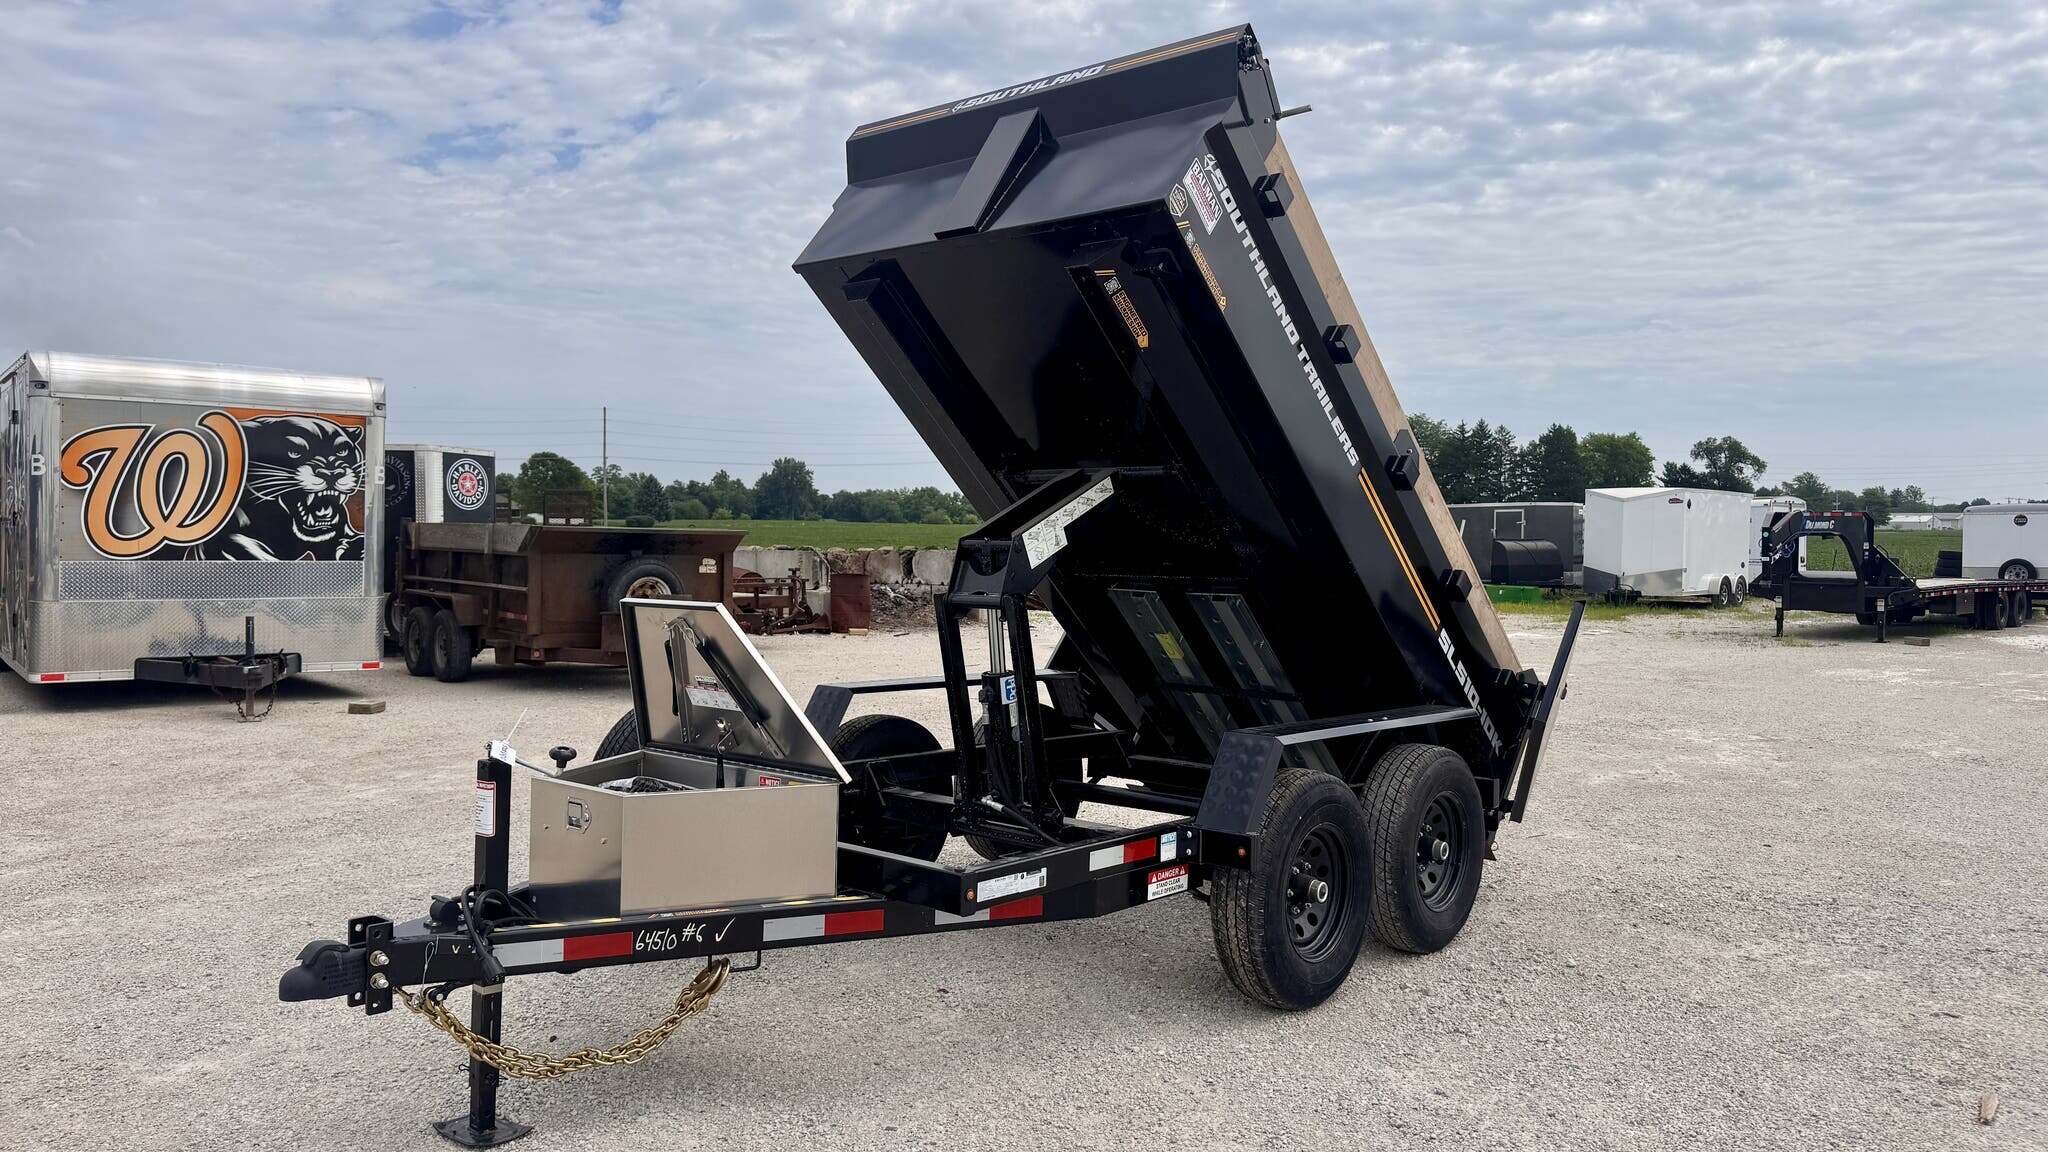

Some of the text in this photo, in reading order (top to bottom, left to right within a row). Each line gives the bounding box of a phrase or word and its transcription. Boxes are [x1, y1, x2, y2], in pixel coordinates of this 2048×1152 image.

[961, 64, 1106, 108] SOUTHLAND
[1210, 168, 1360, 467] SOUTHLAND TRAILERS
[31, 453, 46, 476] B
[452, 463, 483, 480] HARLEY
[451, 484, 484, 505] DAVIDSON
[1438, 627, 1502, 757] SL510-10K
[1158, 868, 1180, 880] DANGER
[1156, 881, 1168, 890] STAND
[681, 922, 707, 943] #6
